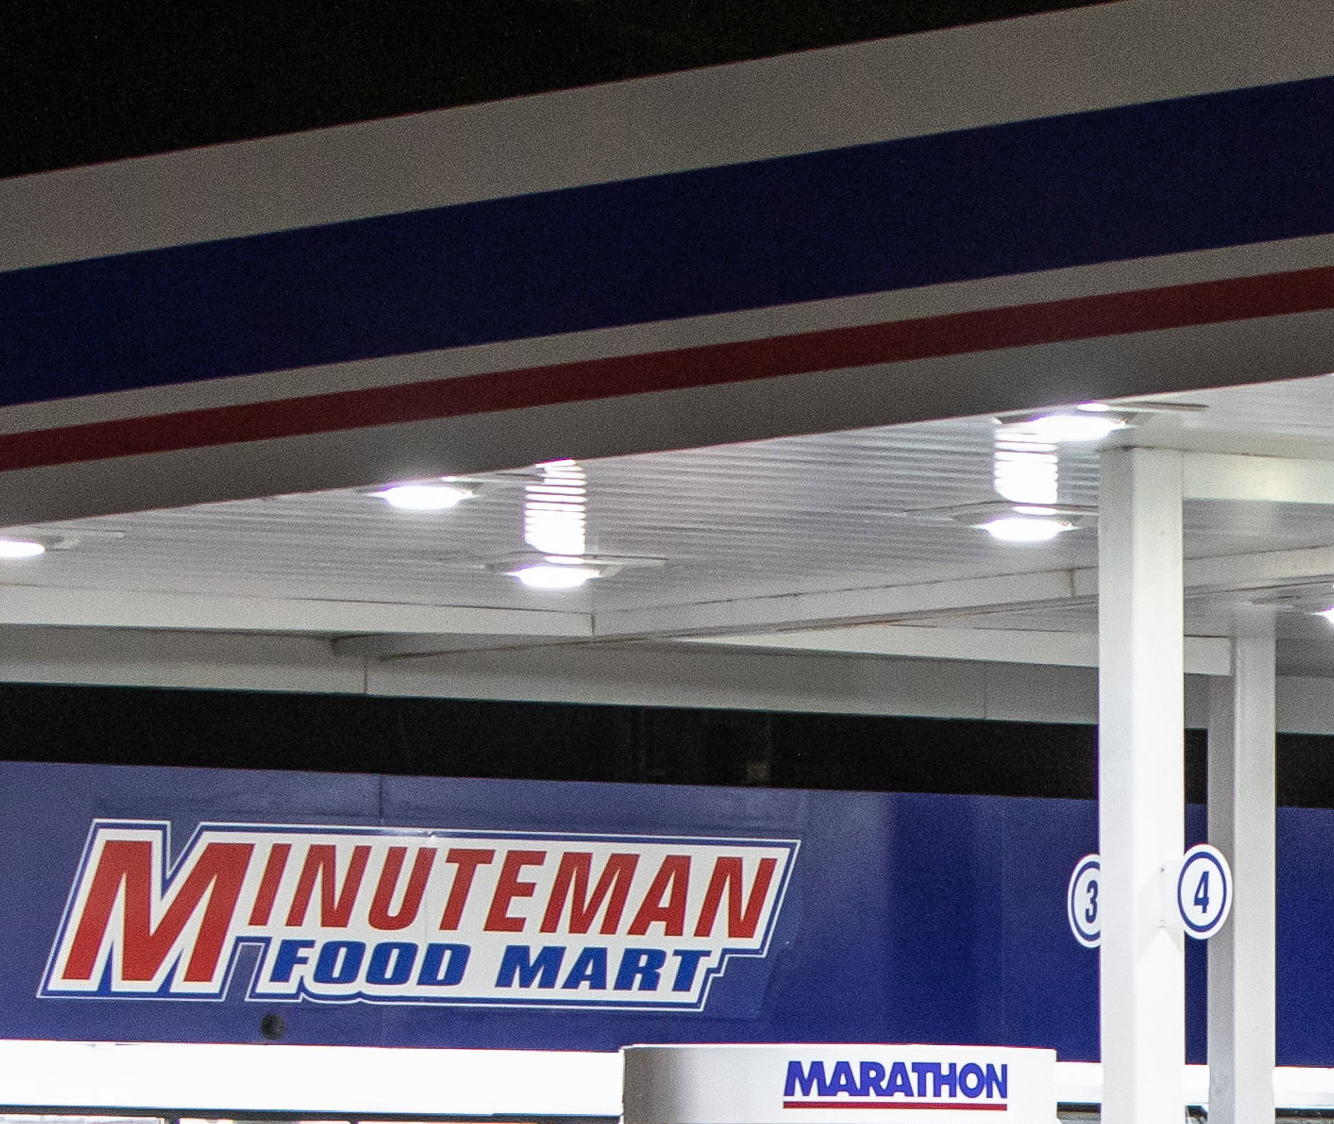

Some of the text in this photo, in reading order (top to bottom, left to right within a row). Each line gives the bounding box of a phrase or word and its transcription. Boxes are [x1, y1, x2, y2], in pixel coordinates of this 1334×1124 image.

[62, 839, 779, 983] MINUTEMAN
[1085, 879, 1099, 924] 3
[1193, 871, 1210, 914] 4
[269, 938, 712, 993] FOOD MART
[783, 1060, 1008, 1099] MARATHON
